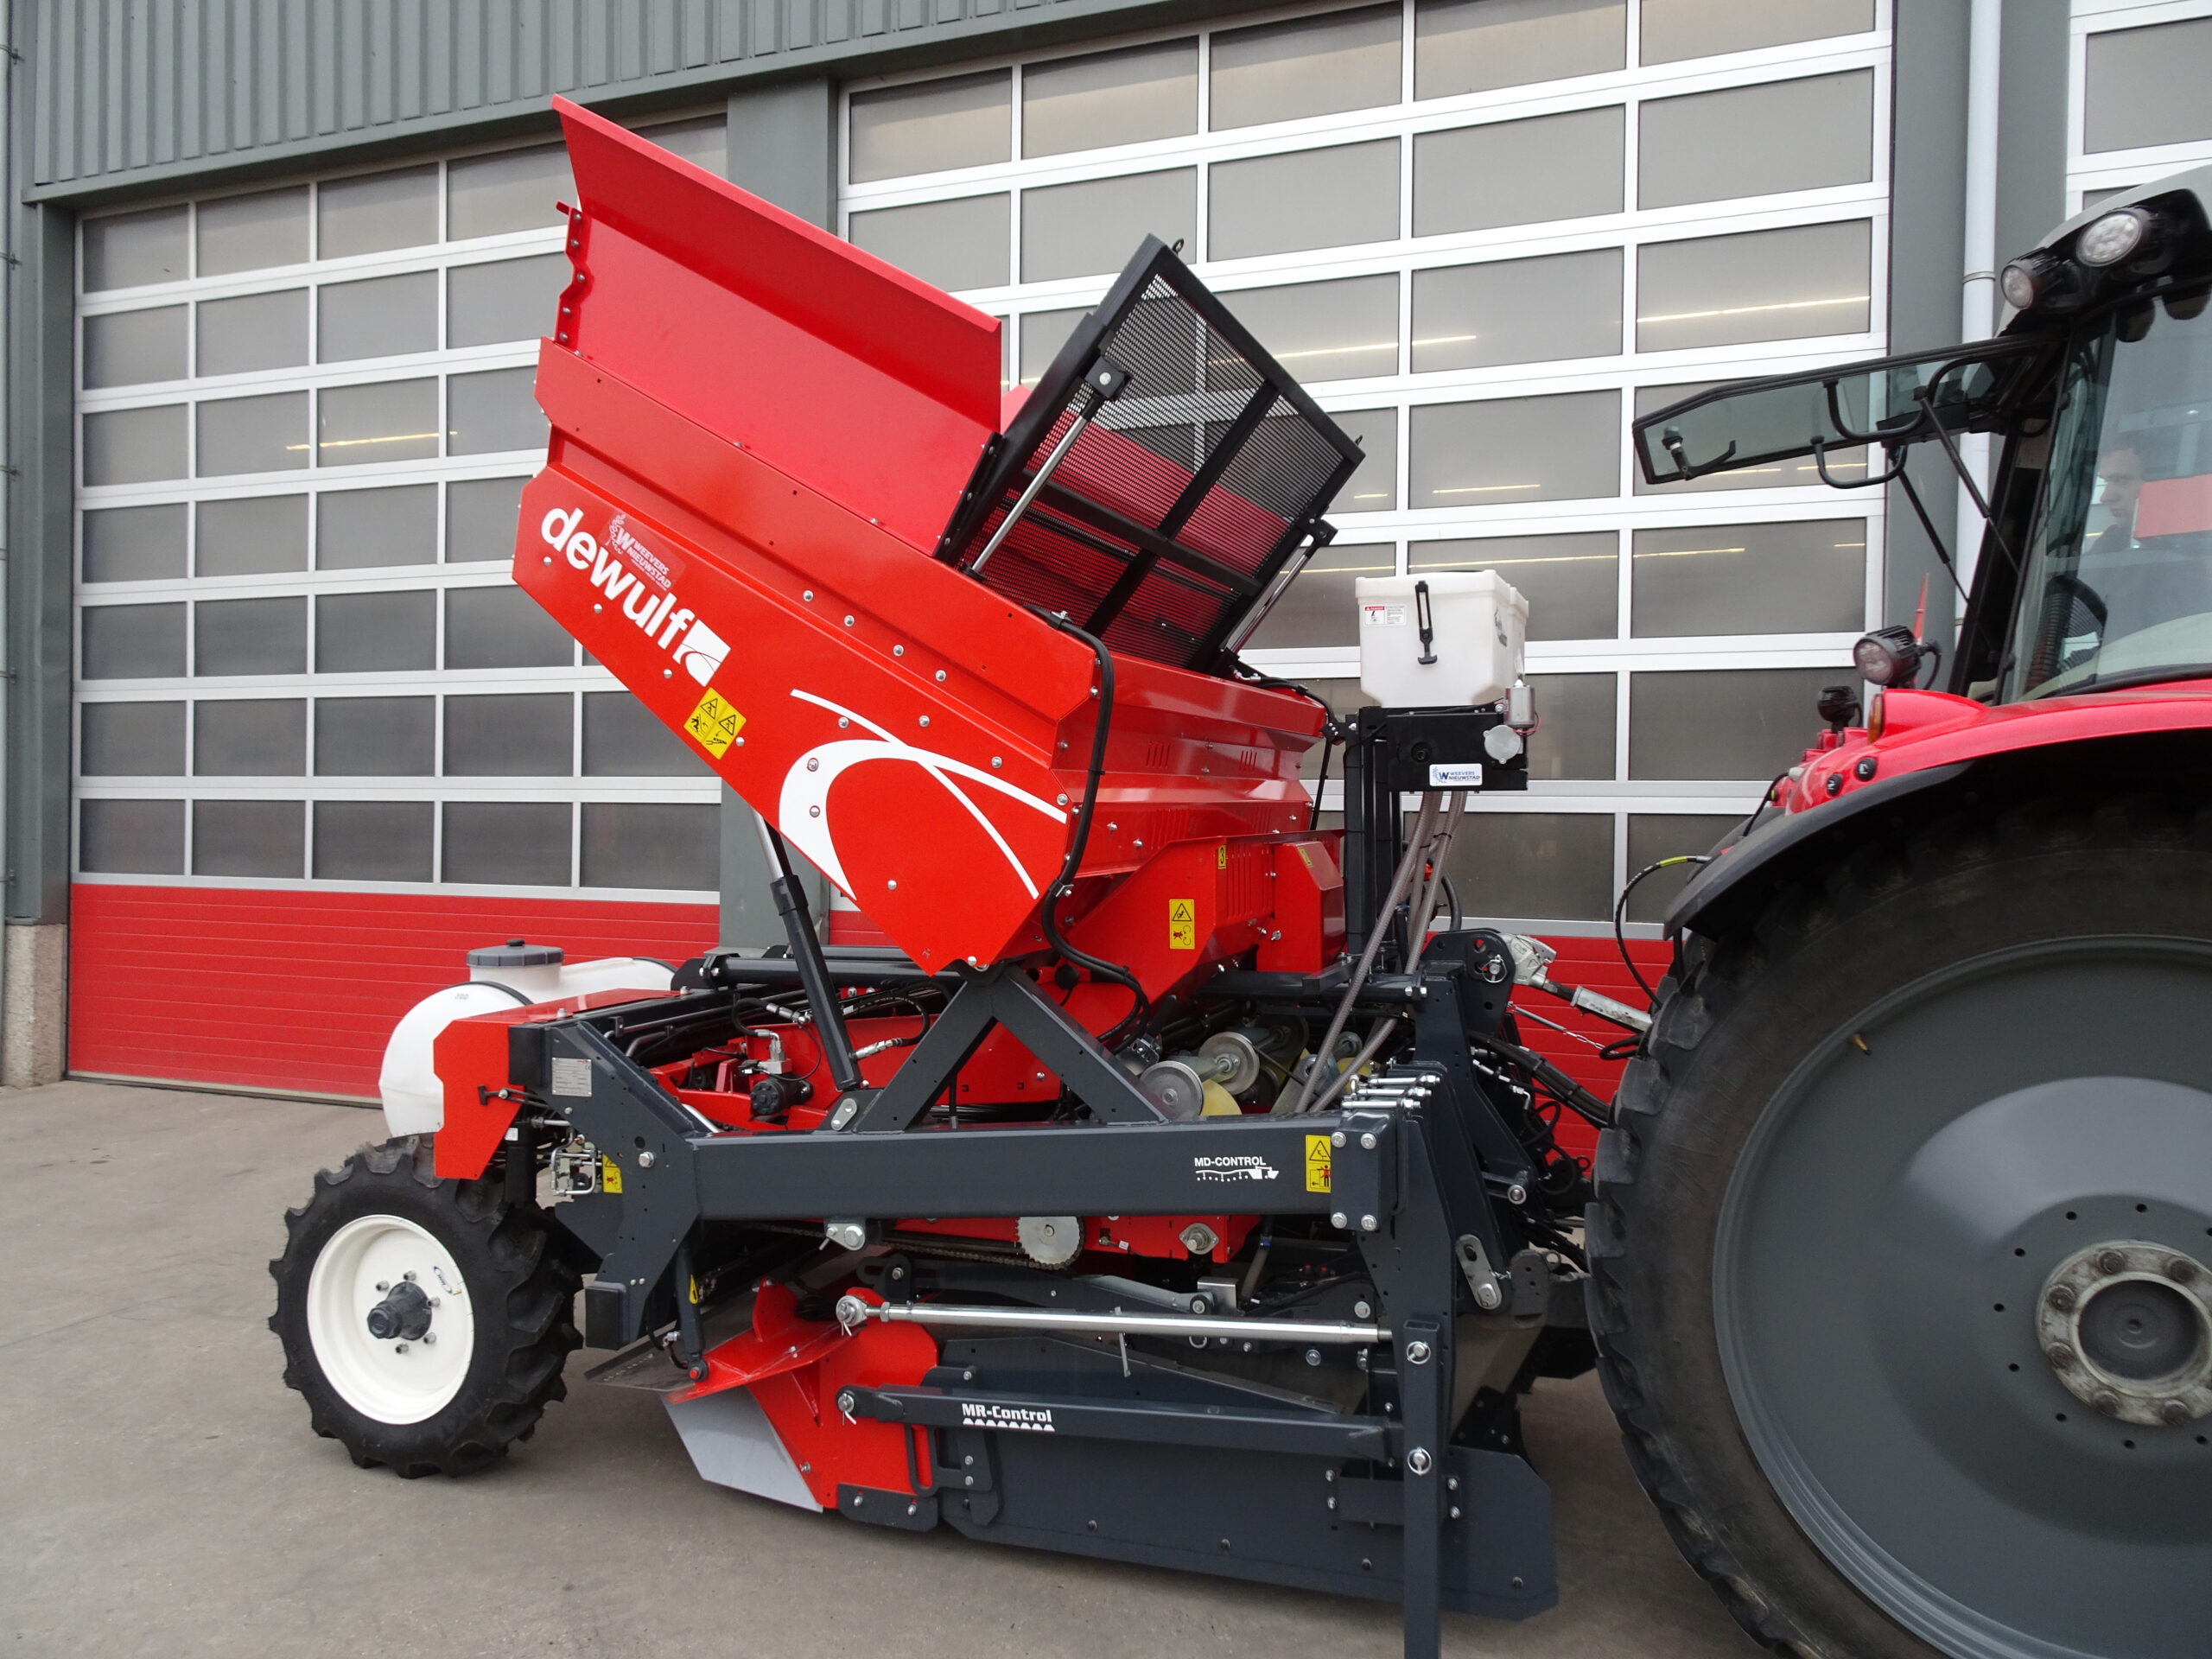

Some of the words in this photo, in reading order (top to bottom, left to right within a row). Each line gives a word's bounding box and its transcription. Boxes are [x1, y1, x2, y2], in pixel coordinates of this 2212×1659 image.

[616, 527, 636, 550] W
[626, 546, 671, 588] NIEUWSTAD
[633, 541, 670, 575] WEEVERS
[541, 507, 695, 649] dewulf
[1194, 1156, 1267, 1166] MD-CONTROL
[962, 1403, 1052, 1422] MR-Control
